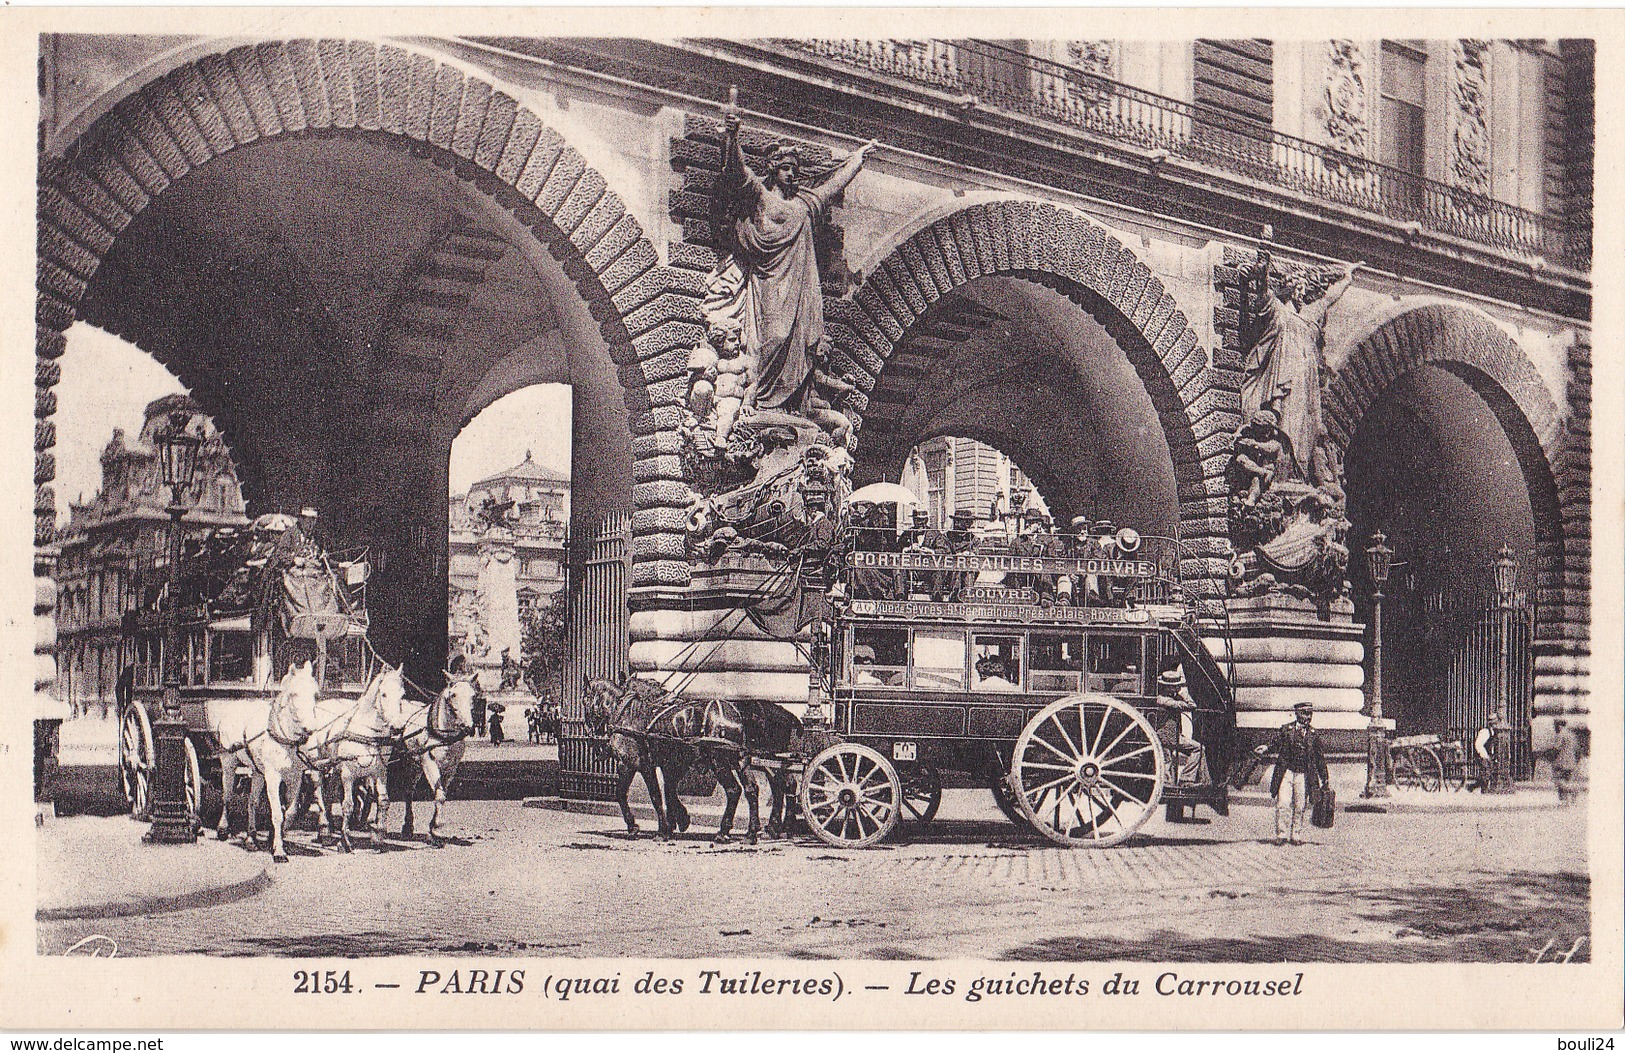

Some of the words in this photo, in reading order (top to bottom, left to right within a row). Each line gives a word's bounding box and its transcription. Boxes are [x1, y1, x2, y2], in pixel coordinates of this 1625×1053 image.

[854, 553, 912, 567] PORTE
[914, 554, 930, 567] de
[932, 555, 1043, 571] VERSAILLES
[1076, 560, 1149, 575] LOUVRE
[965, 588, 1031, 600] LOUVRE
